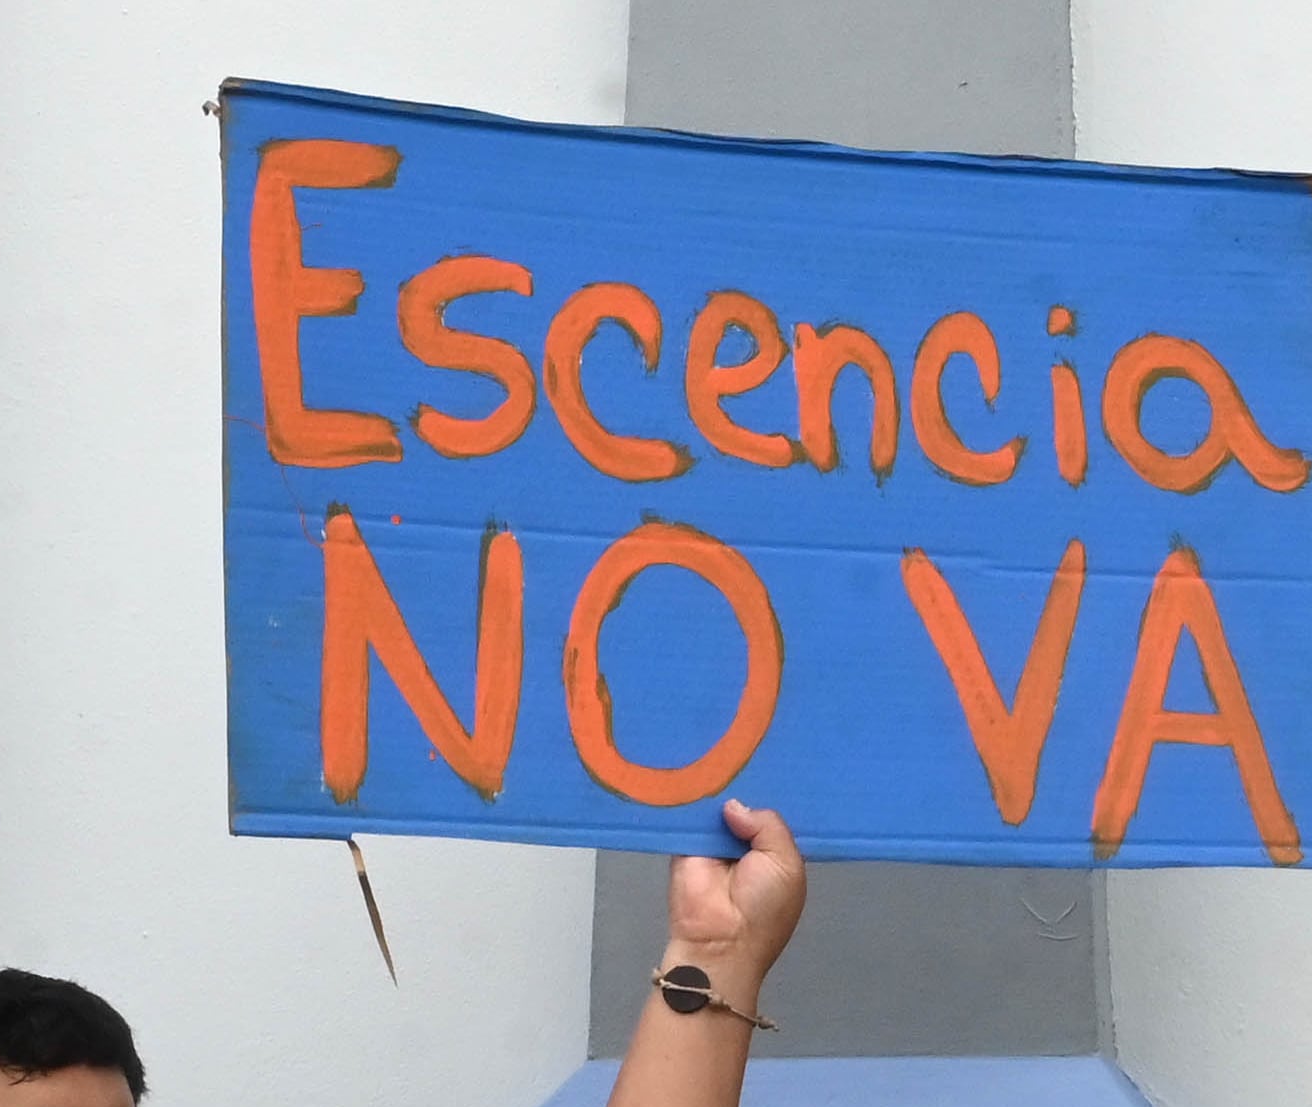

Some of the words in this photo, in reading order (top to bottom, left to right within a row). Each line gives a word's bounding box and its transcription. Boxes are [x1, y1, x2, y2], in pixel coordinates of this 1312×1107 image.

[249, 138, 1312, 493] Escencia
[319, 504, 784, 806] NO
[901, 536, 1302, 864] VA
